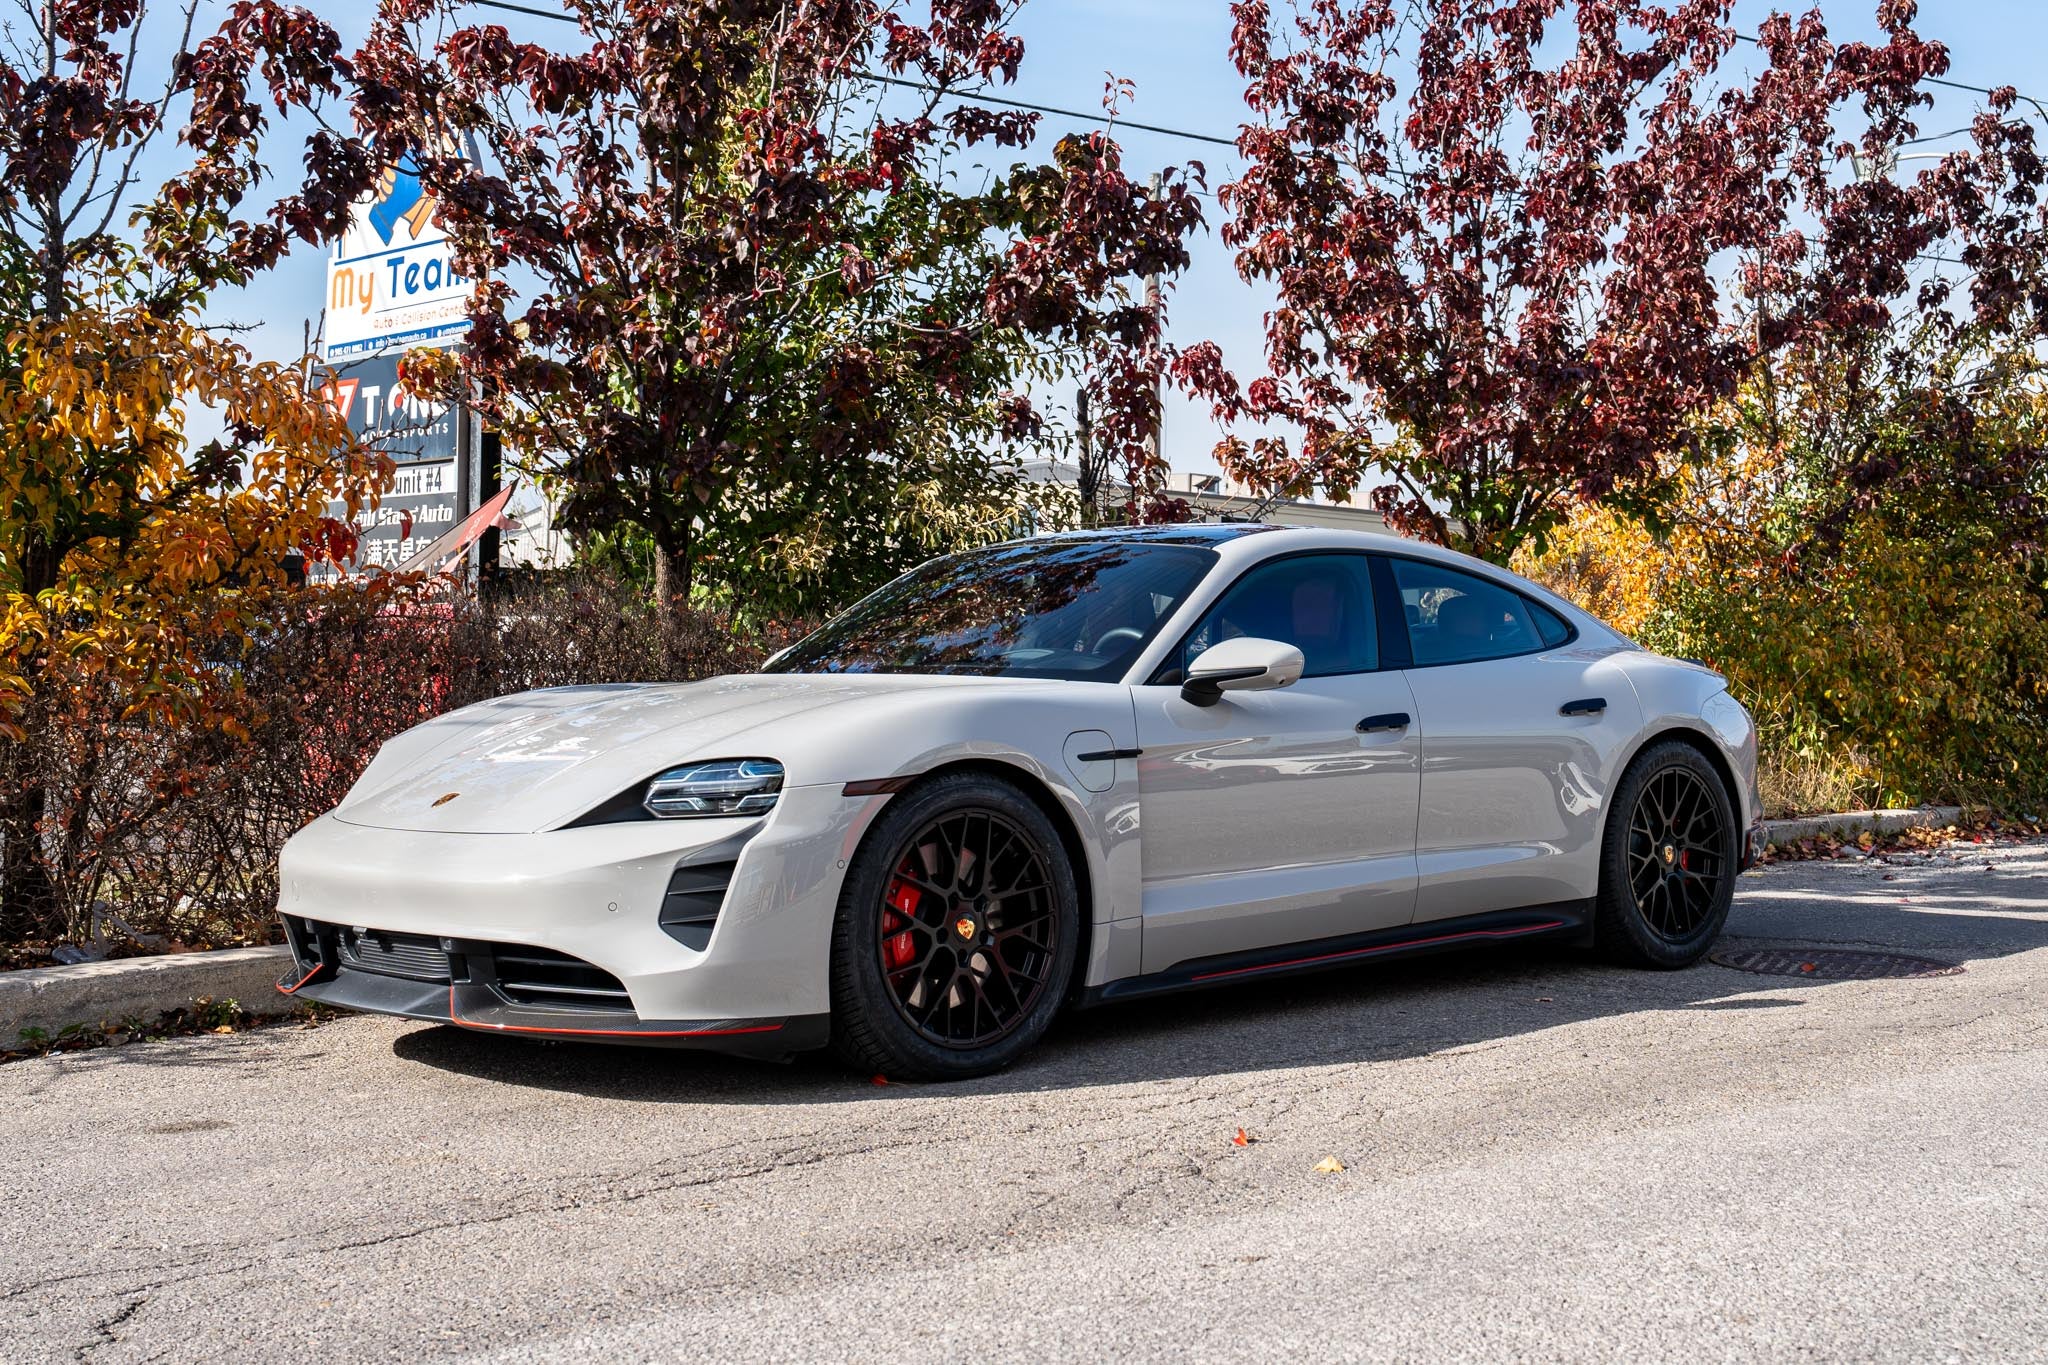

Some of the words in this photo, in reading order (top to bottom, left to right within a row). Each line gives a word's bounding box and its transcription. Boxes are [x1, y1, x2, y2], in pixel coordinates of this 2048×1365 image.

[401, 310, 437, 325] Collision
[426, 467, 442, 493] #4
[418, 504, 453, 523] Auto
